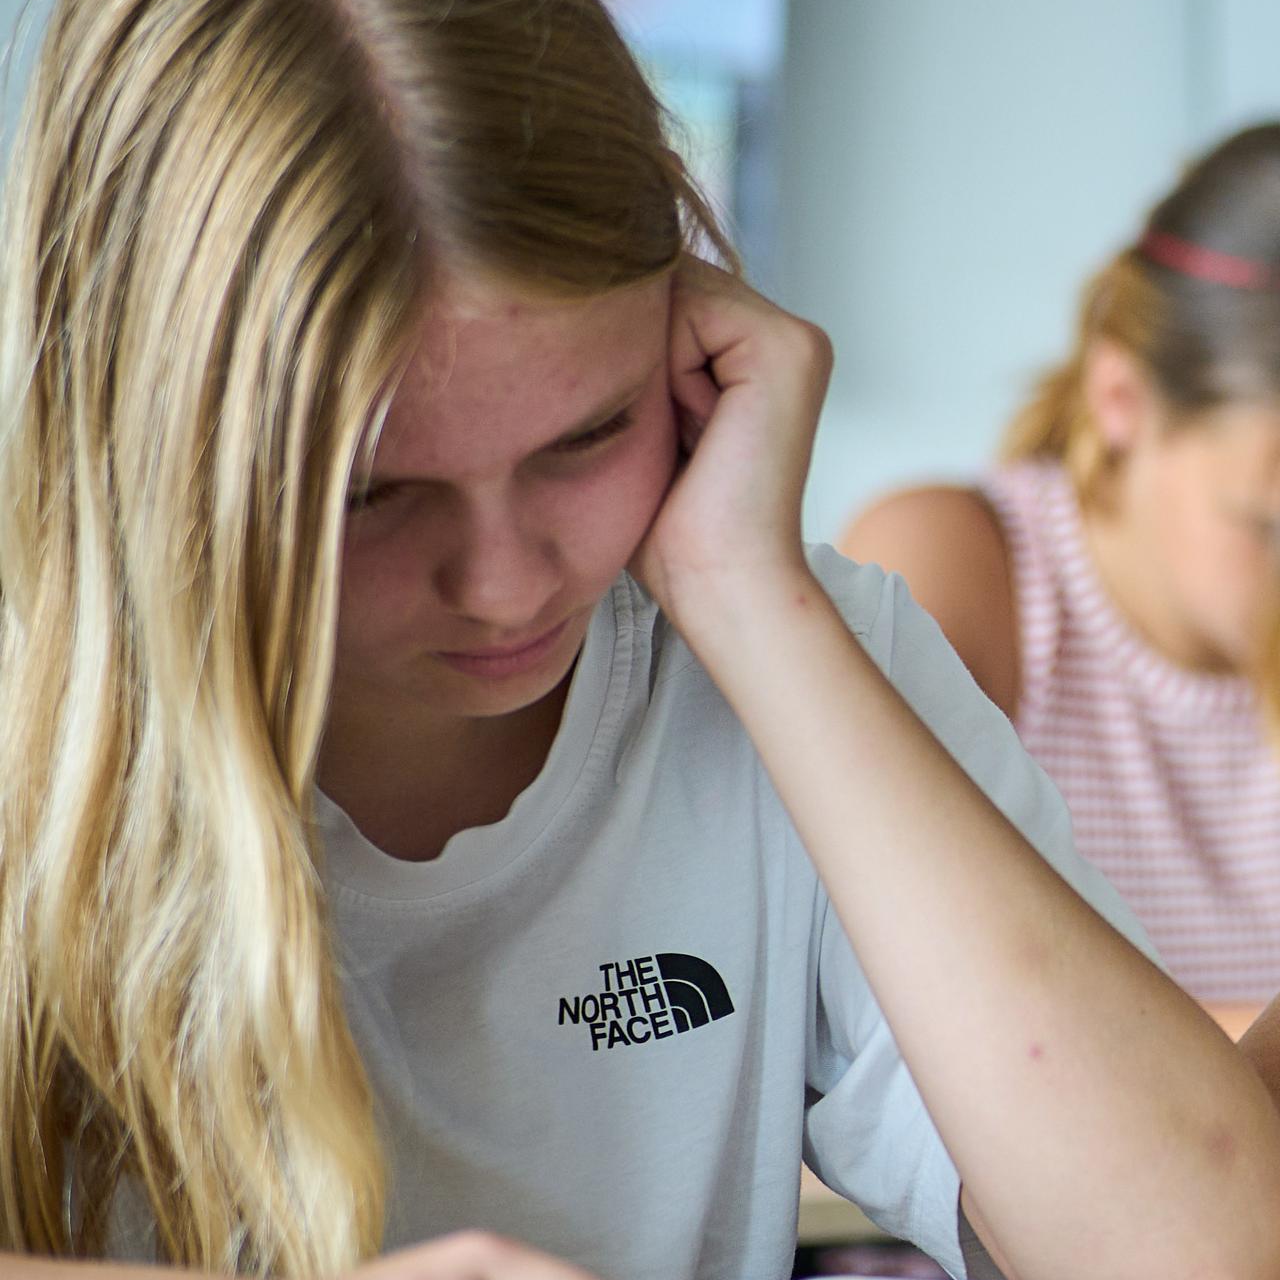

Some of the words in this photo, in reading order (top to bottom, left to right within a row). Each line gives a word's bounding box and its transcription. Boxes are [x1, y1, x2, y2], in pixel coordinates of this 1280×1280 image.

[599, 956, 658, 991] THE
[558, 983, 666, 1025] NORTH
[590, 1010, 673, 1051] FACE
